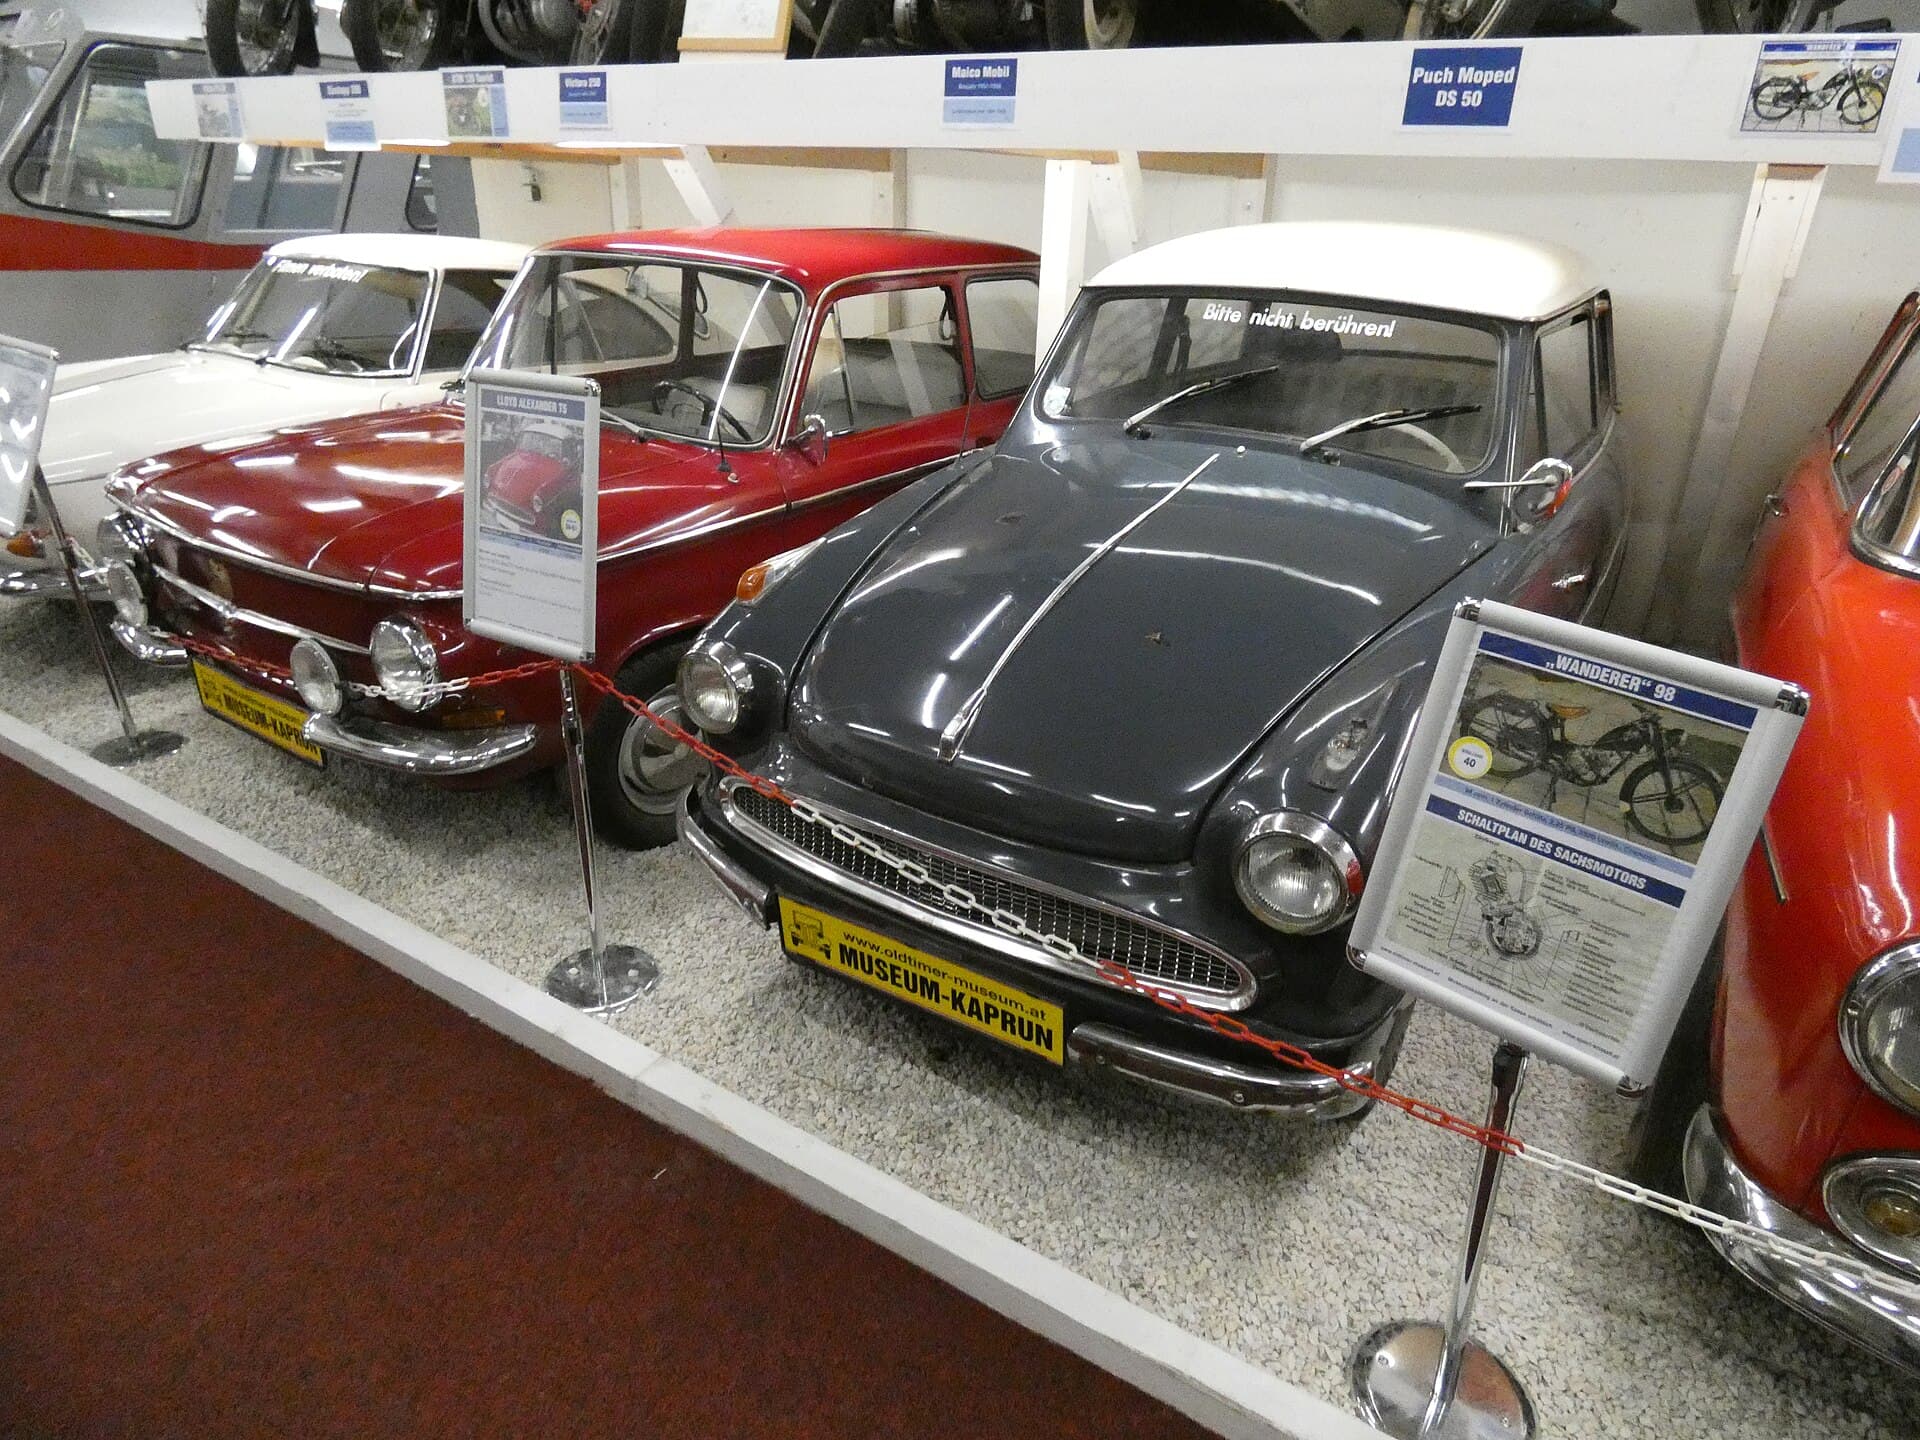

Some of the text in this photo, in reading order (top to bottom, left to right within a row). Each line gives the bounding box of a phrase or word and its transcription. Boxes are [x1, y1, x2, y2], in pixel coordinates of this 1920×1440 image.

[952, 65, 1010, 79] Maico Mobil
[1412, 66, 1516, 87] Puch Moped
[1435, 90, 1483, 107] DS 50
[1202, 303, 1397, 338] Bitte nicht berühren!
[496, 394, 517, 408] LLOYD
[518, 397, 557, 413] ALEXANDER
[1653, 683, 1676, 702] 98
[1463, 757, 1476, 768] 40
[1457, 809, 1528, 845] SCHALTPLAN
[1529, 836, 1553, 854] DES
[1553, 846, 1647, 890] SACHSMOTORS
[843, 929, 1047, 1021] www.oldtimer-museum.at
[838, 942, 1053, 1051] MUSEUM-KAPRUN
